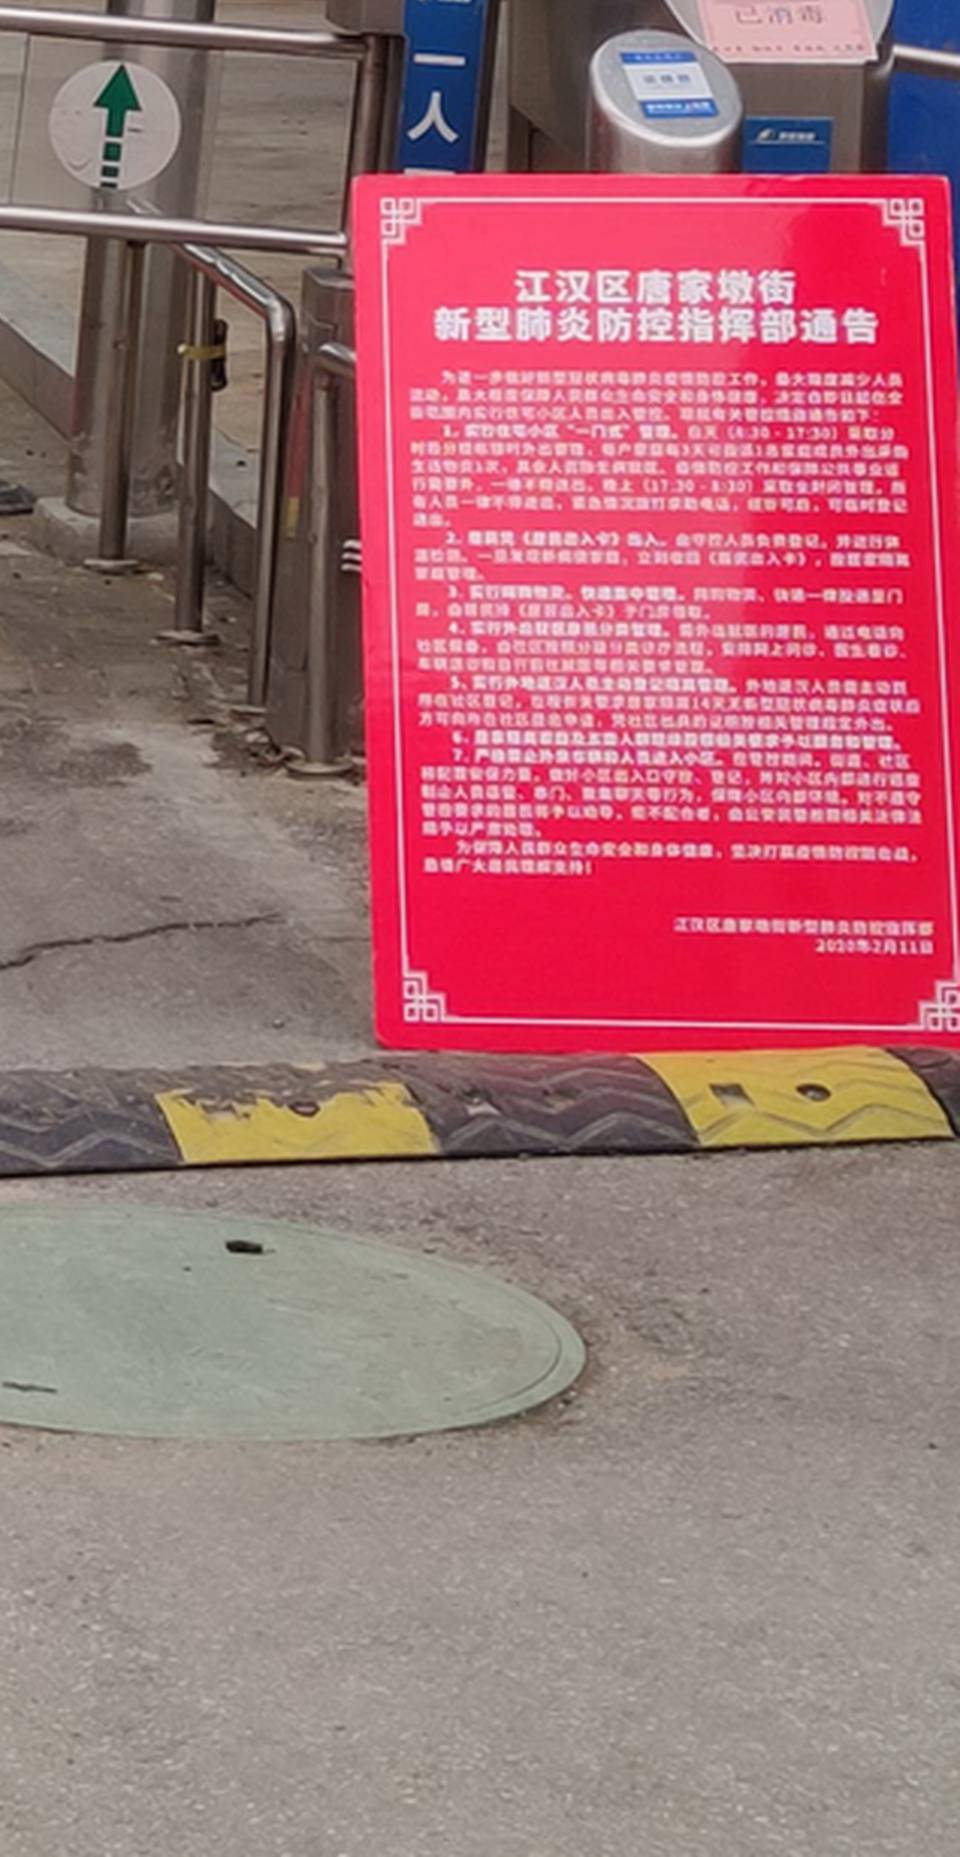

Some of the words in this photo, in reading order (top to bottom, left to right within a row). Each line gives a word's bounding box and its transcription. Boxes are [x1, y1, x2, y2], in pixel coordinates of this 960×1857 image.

[403, 51, 467, 175] 一人
[513, 270, 797, 305] 江汉区唐家墩街
[433, 308, 880, 346] 新型肺炎防控指挥部通告
